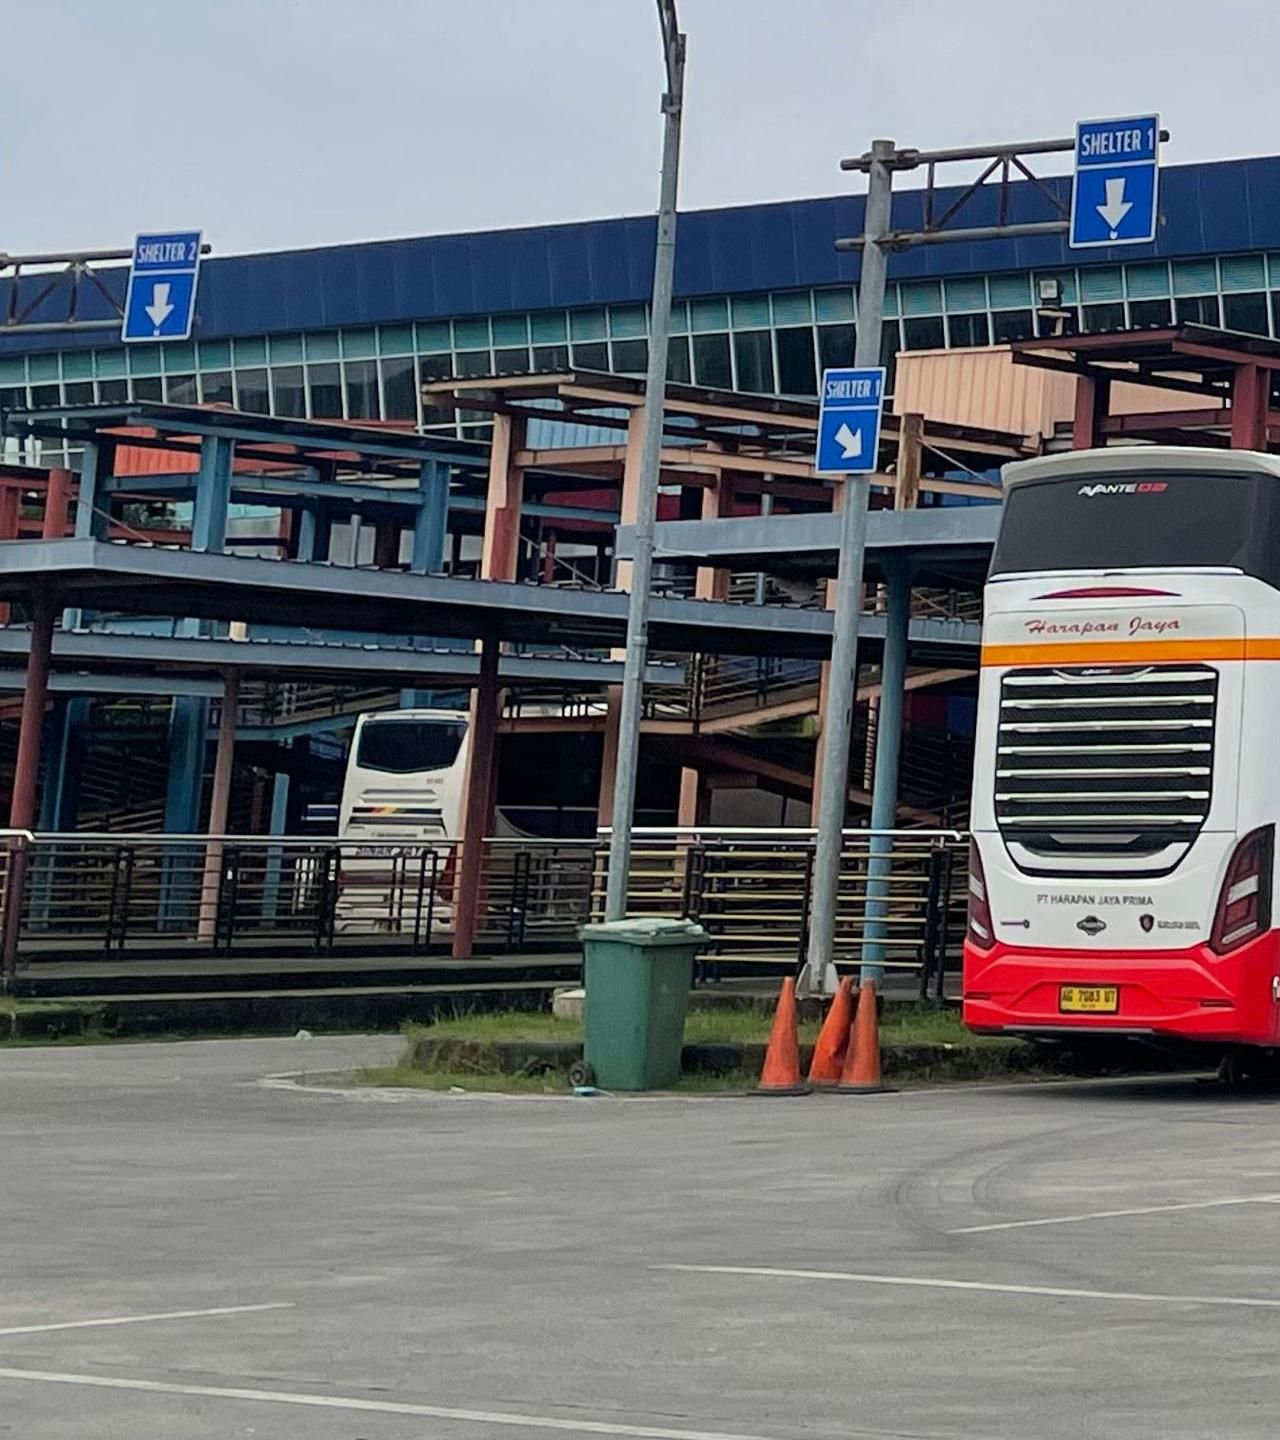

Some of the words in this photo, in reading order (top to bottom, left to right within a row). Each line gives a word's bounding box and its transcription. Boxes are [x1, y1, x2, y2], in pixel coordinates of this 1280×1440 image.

[1081, 129, 1141, 156] SHELTER
[1147, 128, 1153, 150] 1
[137, 242, 186, 264] SHELTER
[188, 241, 197, 261] 2
[826, 379, 871, 399] SHELTER
[875, 379, 880, 397] 1
[1024, 619, 1119, 636] Harapan
[1129, 616, 1180, 636] Jaya
[1037, 894, 1048, 905] PT
[1050, 894, 1095, 905] HARAPAN
[1098, 895, 1120, 906] JAYA
[1123, 895, 1154, 906] PRIMA
